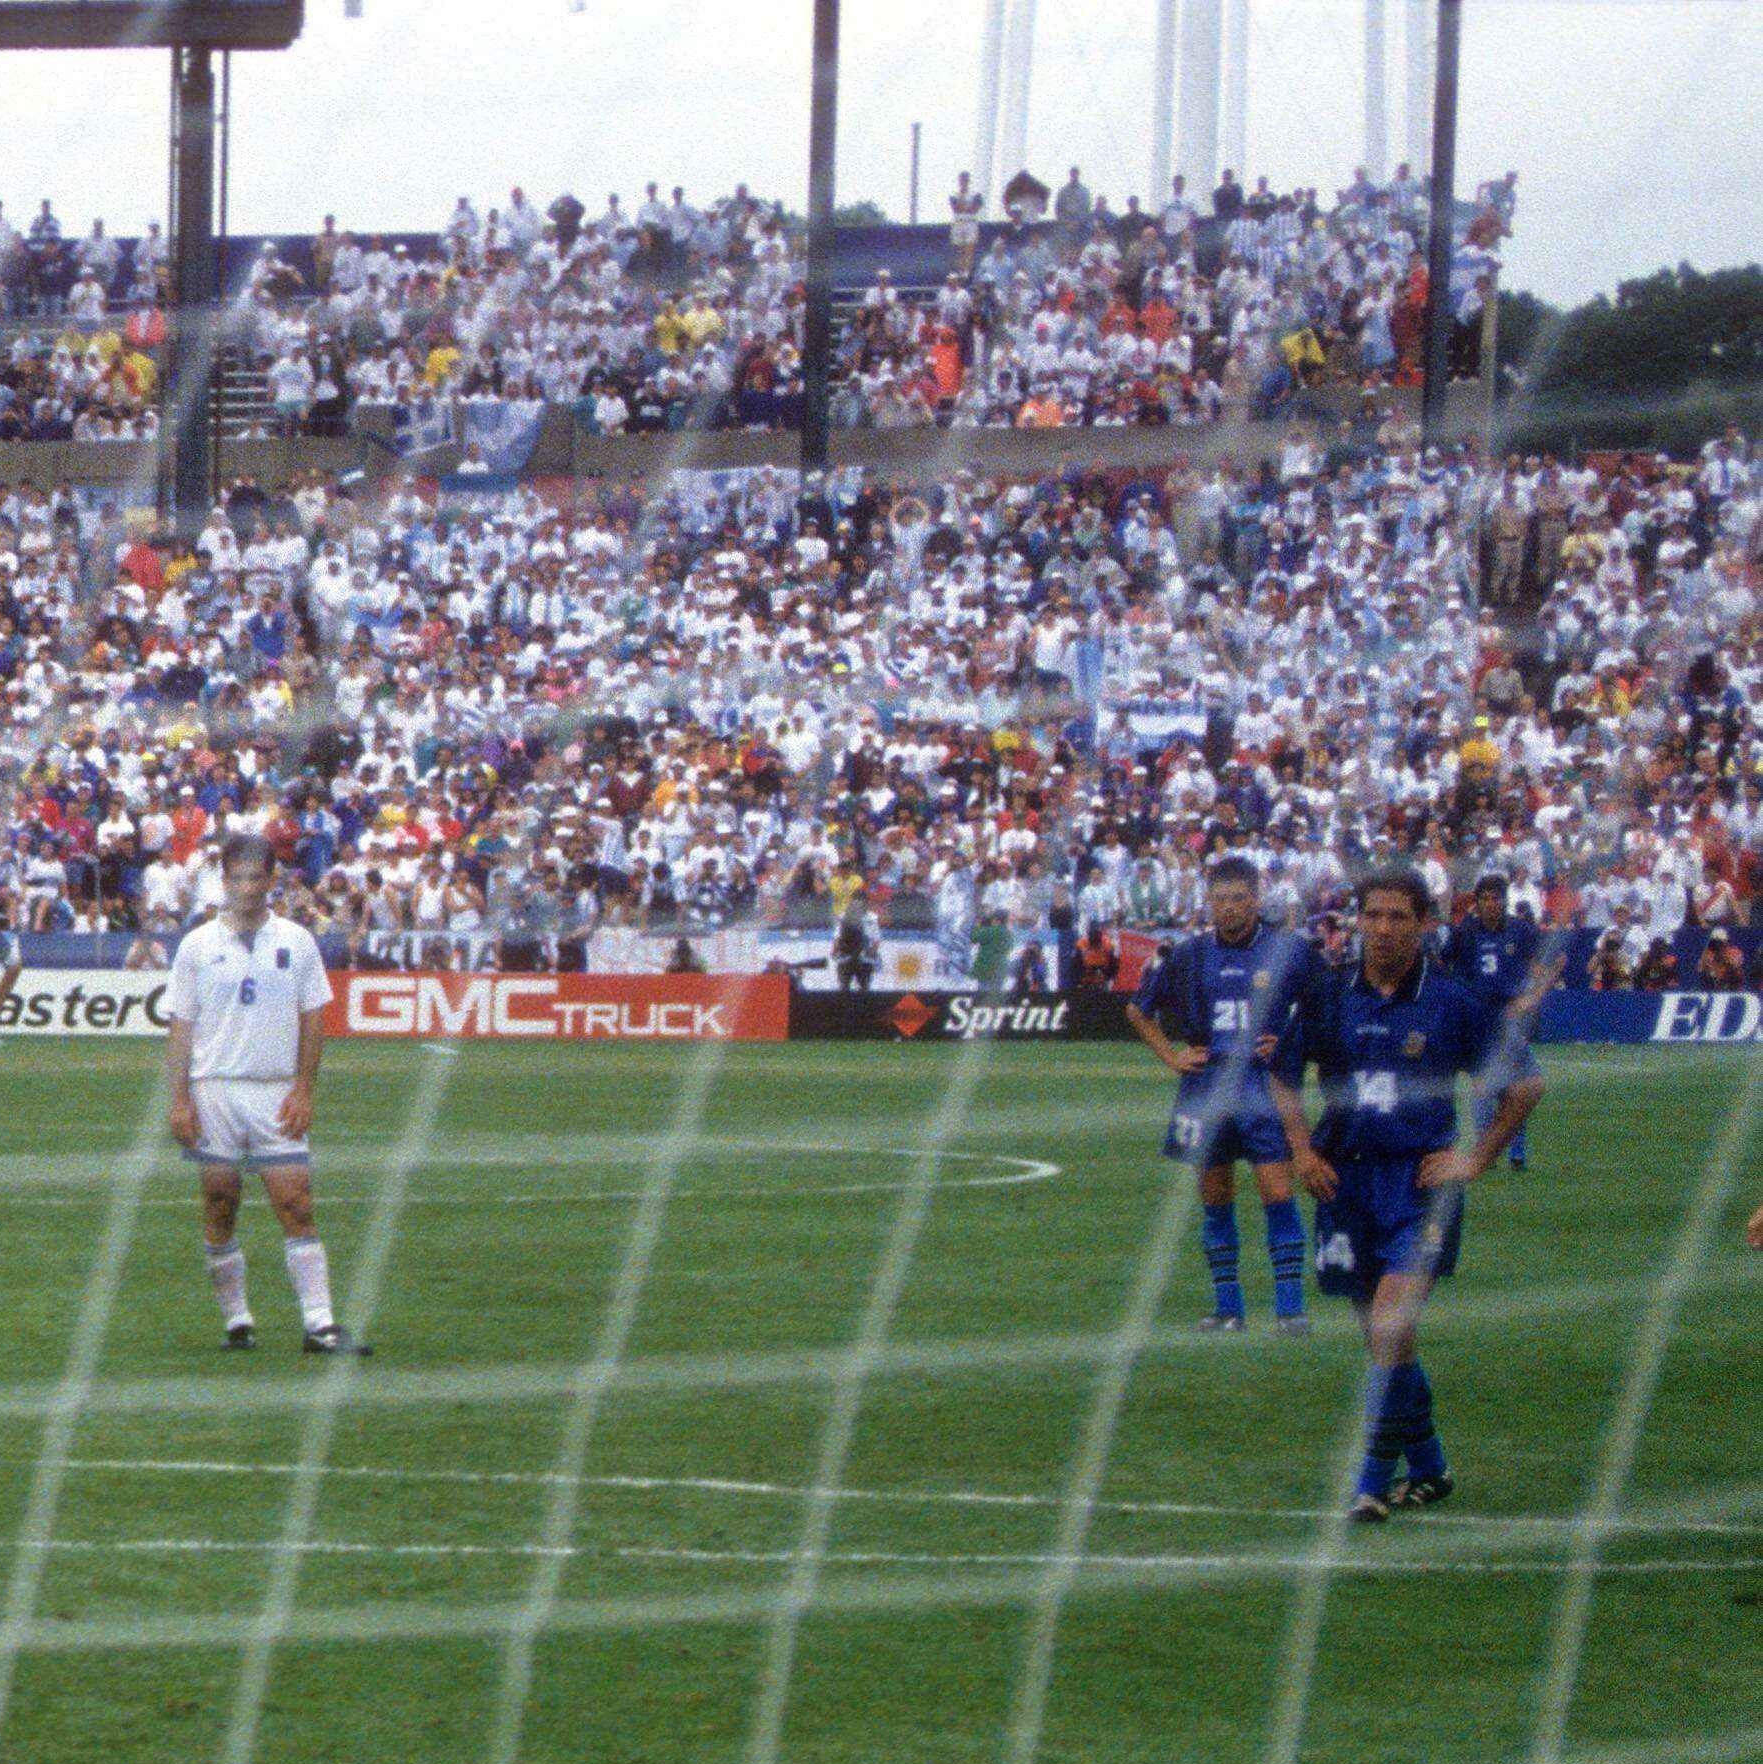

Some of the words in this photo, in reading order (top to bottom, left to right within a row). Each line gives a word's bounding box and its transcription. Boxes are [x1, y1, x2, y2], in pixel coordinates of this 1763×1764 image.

[1481, 953, 1498, 975] 3
[239, 976, 256, 1006] 6
[347, 976, 559, 1035] GMC
[552, 1002, 728, 1037] TRUCK
[945, 997, 1068, 1039] Sprint
[1212, 1000, 1250, 1032] 21
[1651, 992, 1763, 1041] ED
